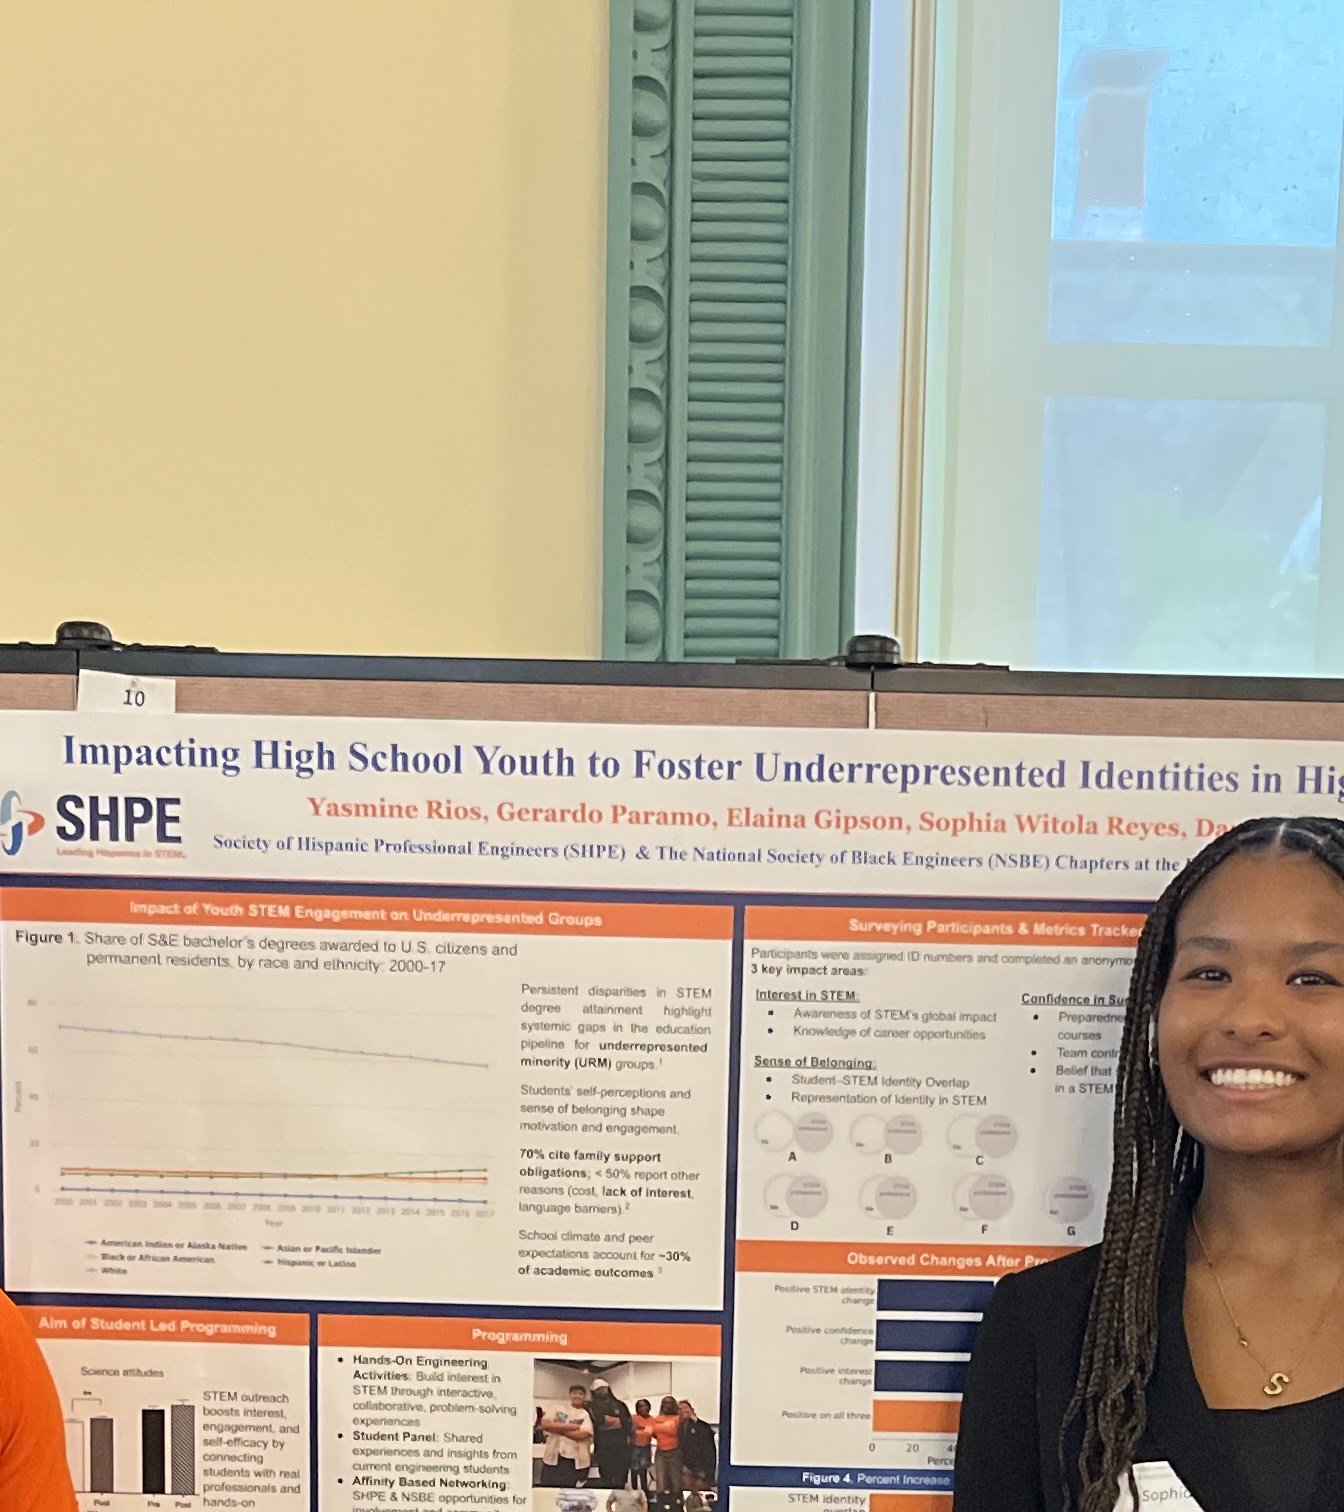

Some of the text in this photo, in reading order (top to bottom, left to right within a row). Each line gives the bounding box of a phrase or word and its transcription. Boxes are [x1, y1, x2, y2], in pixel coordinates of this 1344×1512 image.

[64, 734, 240, 777] Impacting
[253, 739, 334, 779] High
[348, 741, 462, 774] School
[473, 745, 574, 776] Youth
[588, 751, 620, 778] to
[634, 749, 742, 781] Foster
[755, 751, 1065, 796] Underrepresented
[1080, 759, 1238, 792] Identities
[1251, 763, 1281, 793] in
[55, 794, 182, 844] SHPE
[306, 795, 418, 819] Yasmine
[426, 798, 488, 823] Rios,
[496, 800, 602, 823] Gerardo
[611, 804, 718, 829] Paramo,
[726, 806, 806, 828] Elaina
[814, 807, 911, 836] Gipson,
[918, 810, 1006, 838] Sophia
[1014, 812, 1098, 835] Witola
[1106, 815, 1187, 842] Reyes,
